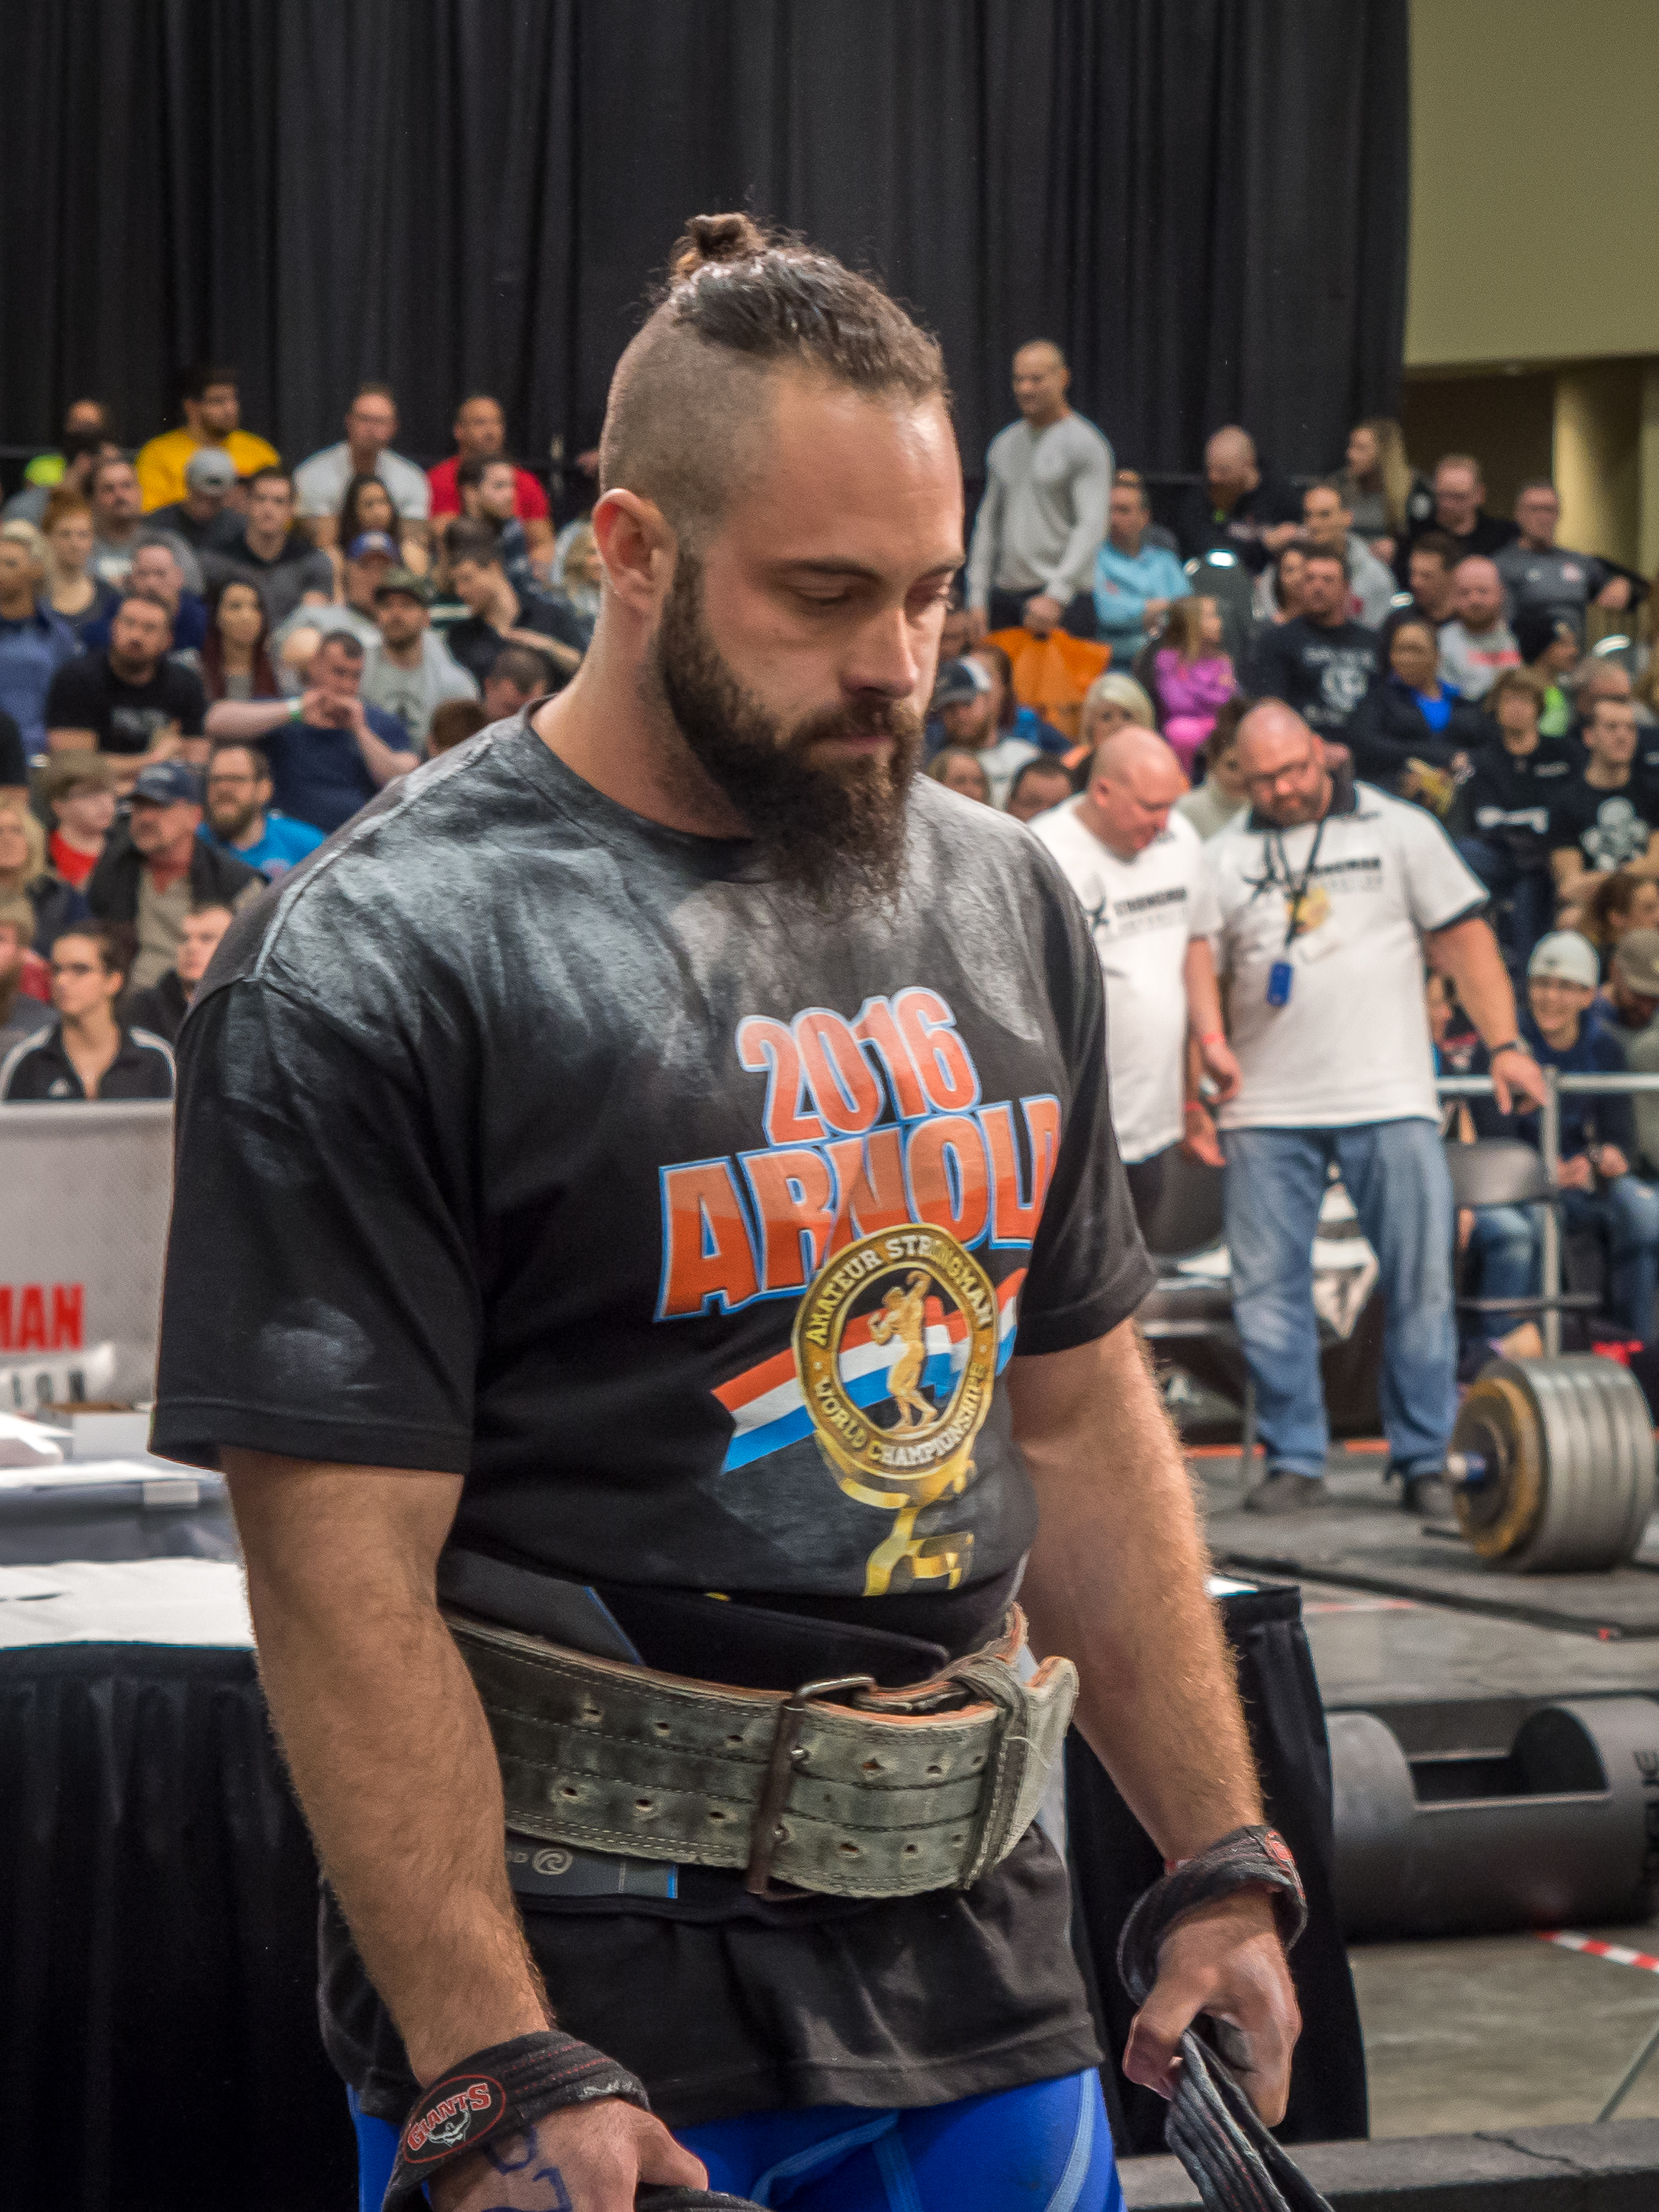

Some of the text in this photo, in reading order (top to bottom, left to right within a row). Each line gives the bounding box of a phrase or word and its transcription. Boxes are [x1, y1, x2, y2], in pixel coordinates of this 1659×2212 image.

[735, 986, 981, 1148] 2016
[805, 1234, 993, 1348] AMATEUR STRONGMAN
[814, 1374, 867, 1449] WORLD
[407, 2082, 492, 2151] GIANTS
